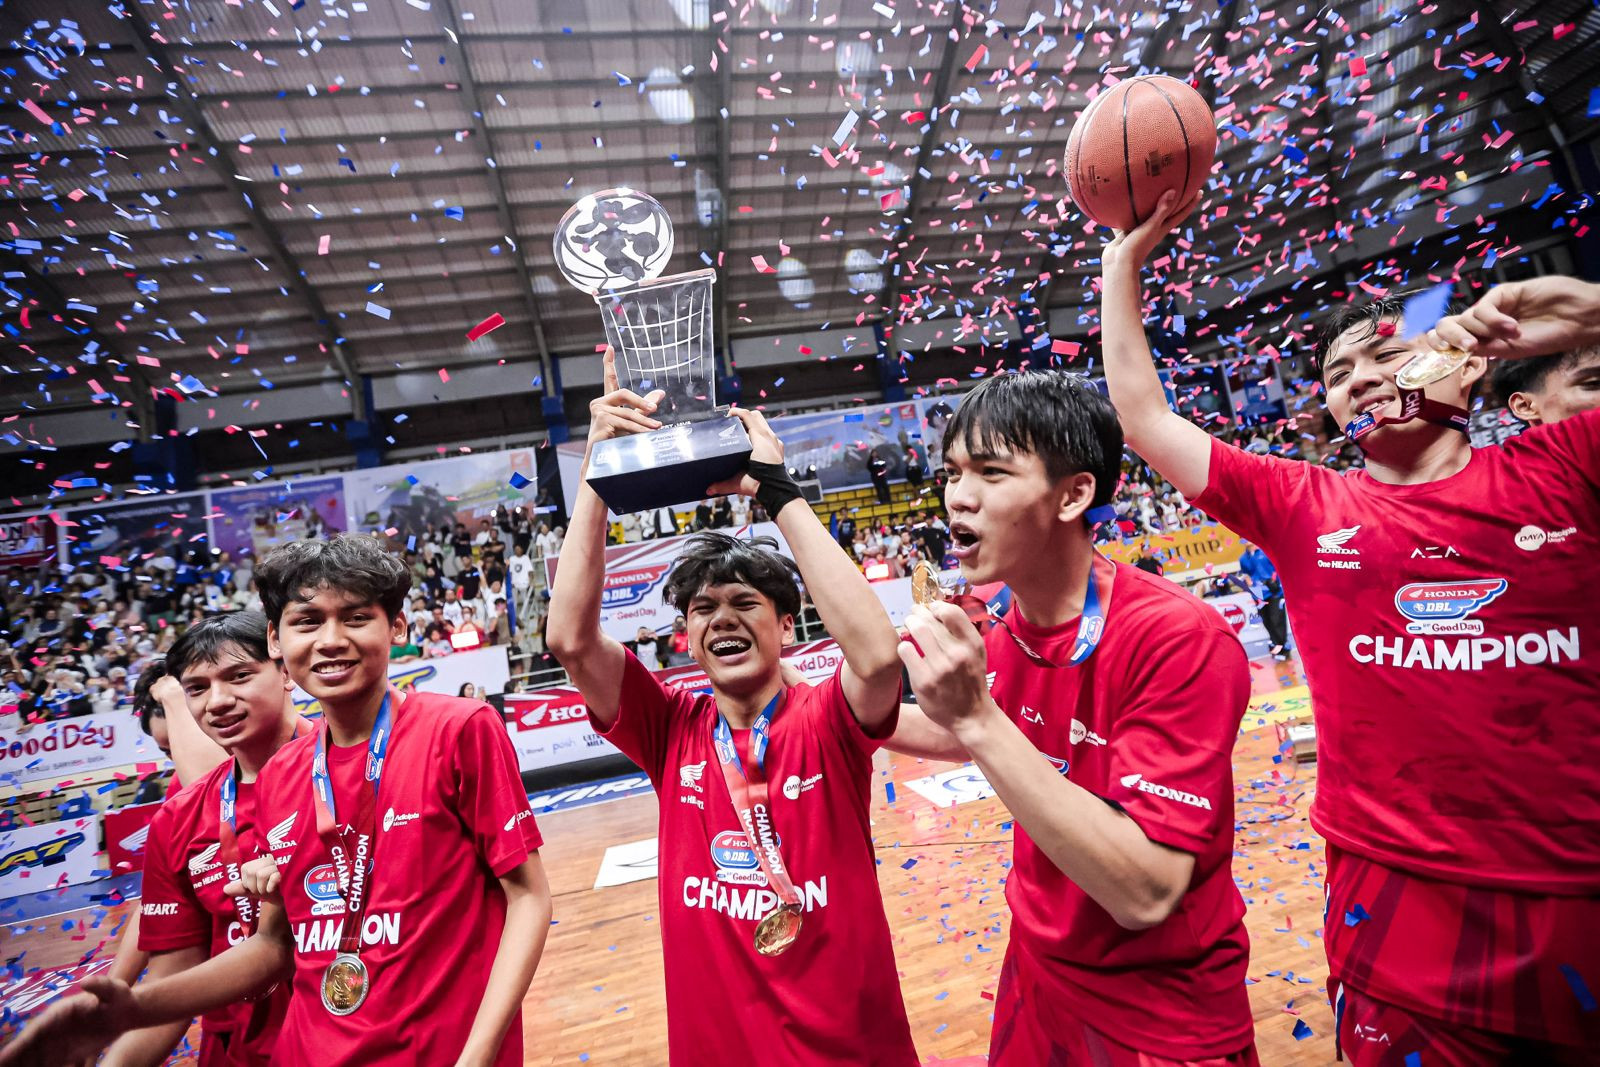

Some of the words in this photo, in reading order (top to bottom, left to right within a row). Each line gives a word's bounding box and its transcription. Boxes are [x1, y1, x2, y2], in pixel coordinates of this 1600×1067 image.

[1317, 560, 1331, 568] One
[609, 572, 654, 585] HONDA
[1424, 590, 1479, 598] HONDA
[1425, 602, 1452, 612] DBL
[1348, 626, 1581, 671] CHAMPION
[1138, 780, 1213, 811] HONDA
[754, 803, 784, 875] CHAMPION
[731, 851, 750, 862] DBL
[349, 834, 370, 913] CHAMPION
[683, 875, 828, 921] CHAMPN
